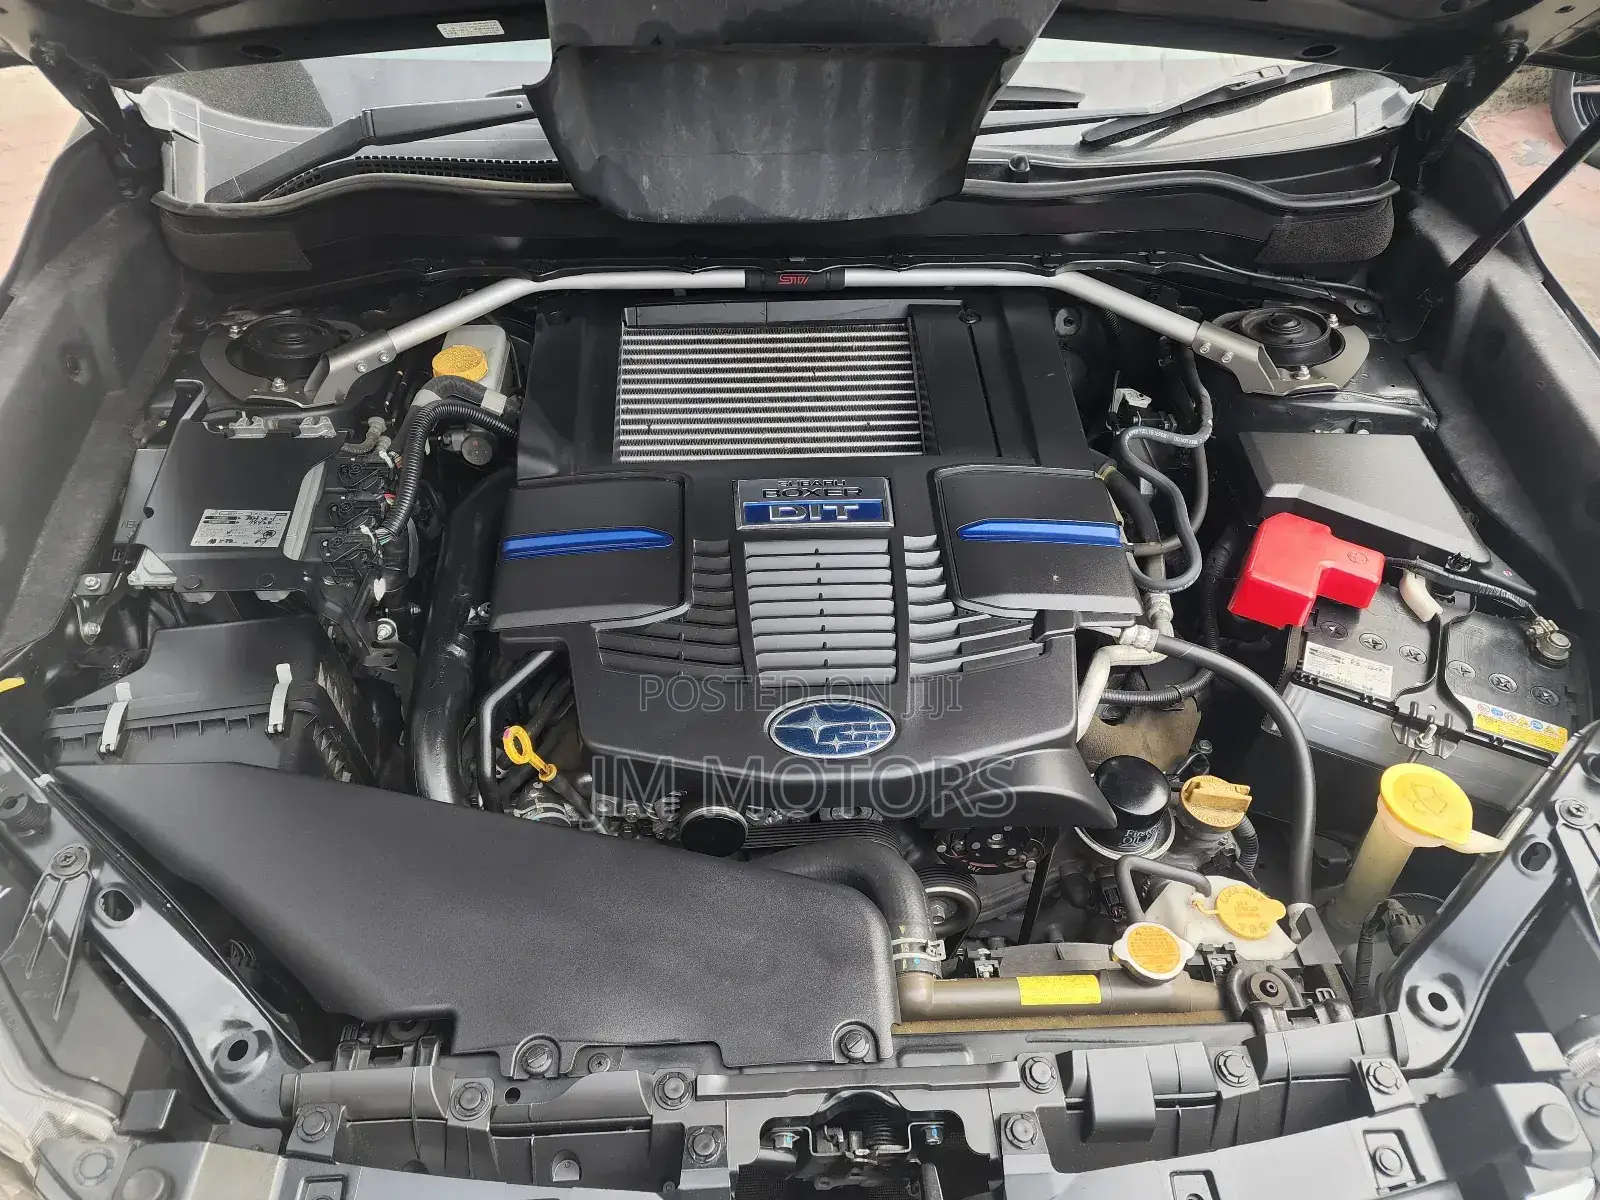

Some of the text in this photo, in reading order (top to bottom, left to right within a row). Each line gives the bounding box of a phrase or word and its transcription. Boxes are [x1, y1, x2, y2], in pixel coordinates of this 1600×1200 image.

[778, 479, 846, 487] SUBARU
[762, 487, 863, 499] BOXER
[769, 504, 860, 522] DIT
